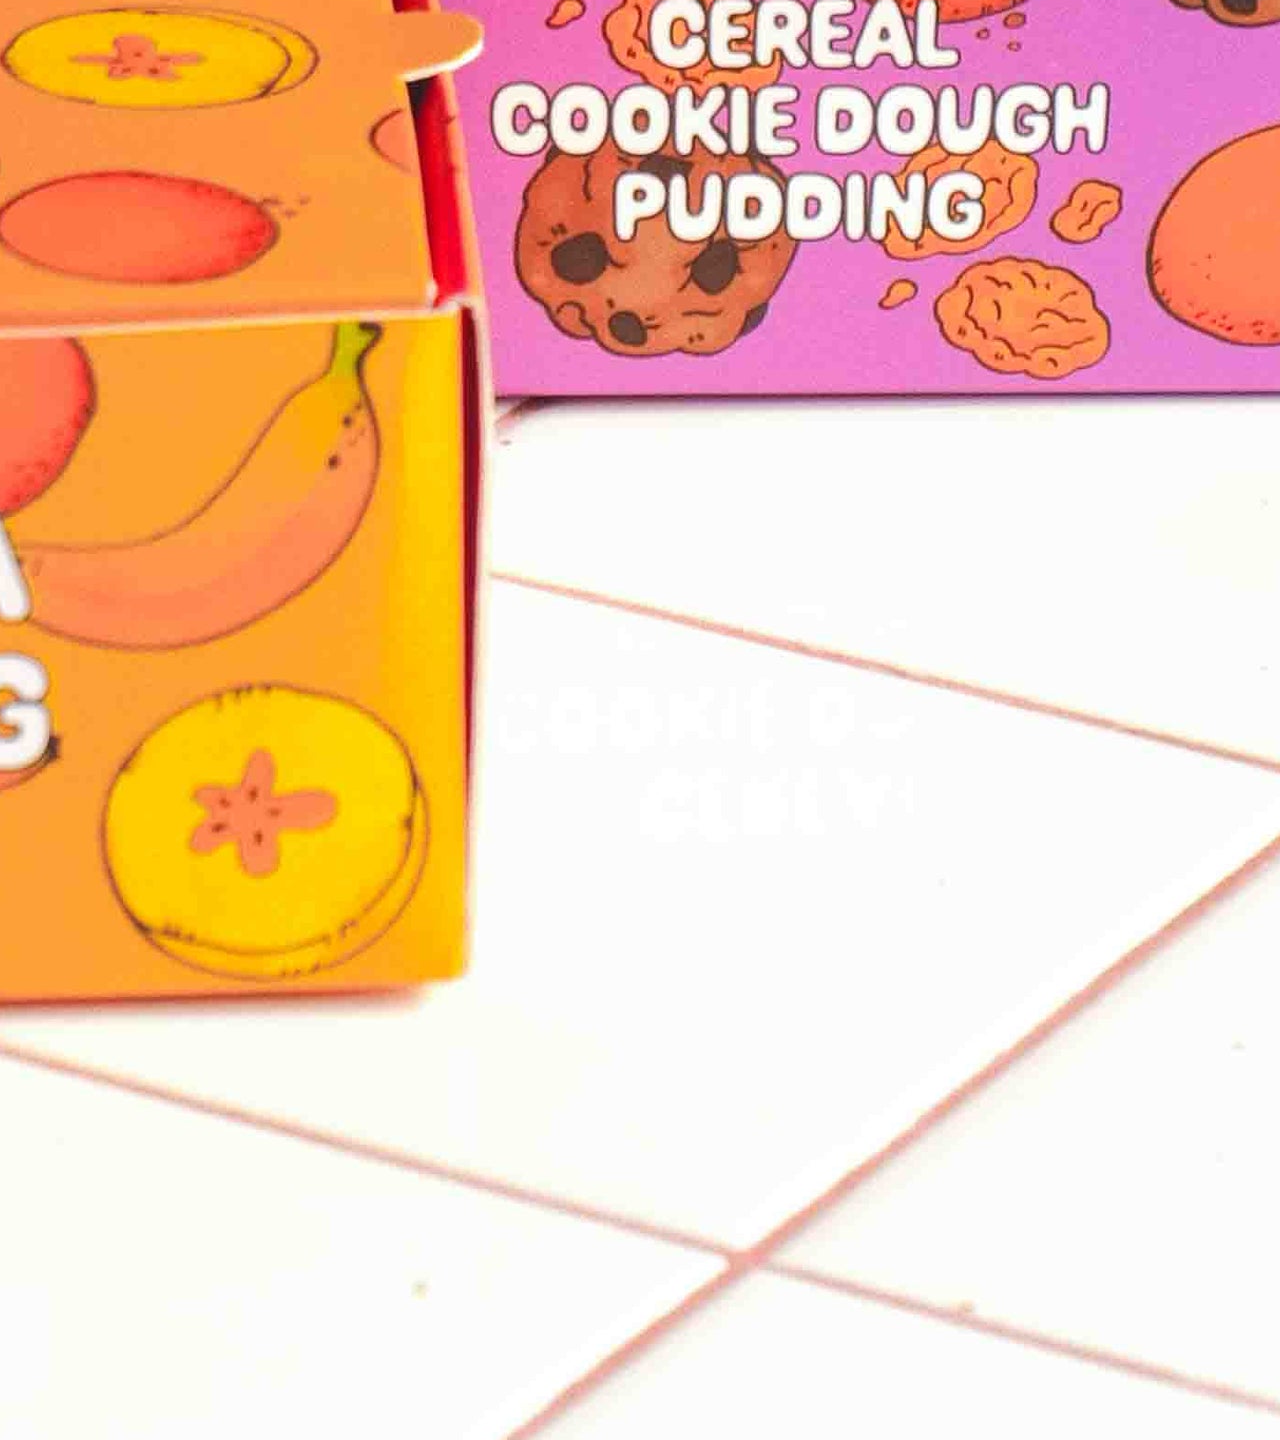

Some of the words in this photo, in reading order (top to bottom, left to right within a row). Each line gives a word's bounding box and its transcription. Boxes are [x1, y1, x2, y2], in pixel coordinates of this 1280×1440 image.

[490, 82, 800, 157] COOKIE
[815, 82, 1111, 156] DOUGH
[613, 171, 986, 242] PUDDING
